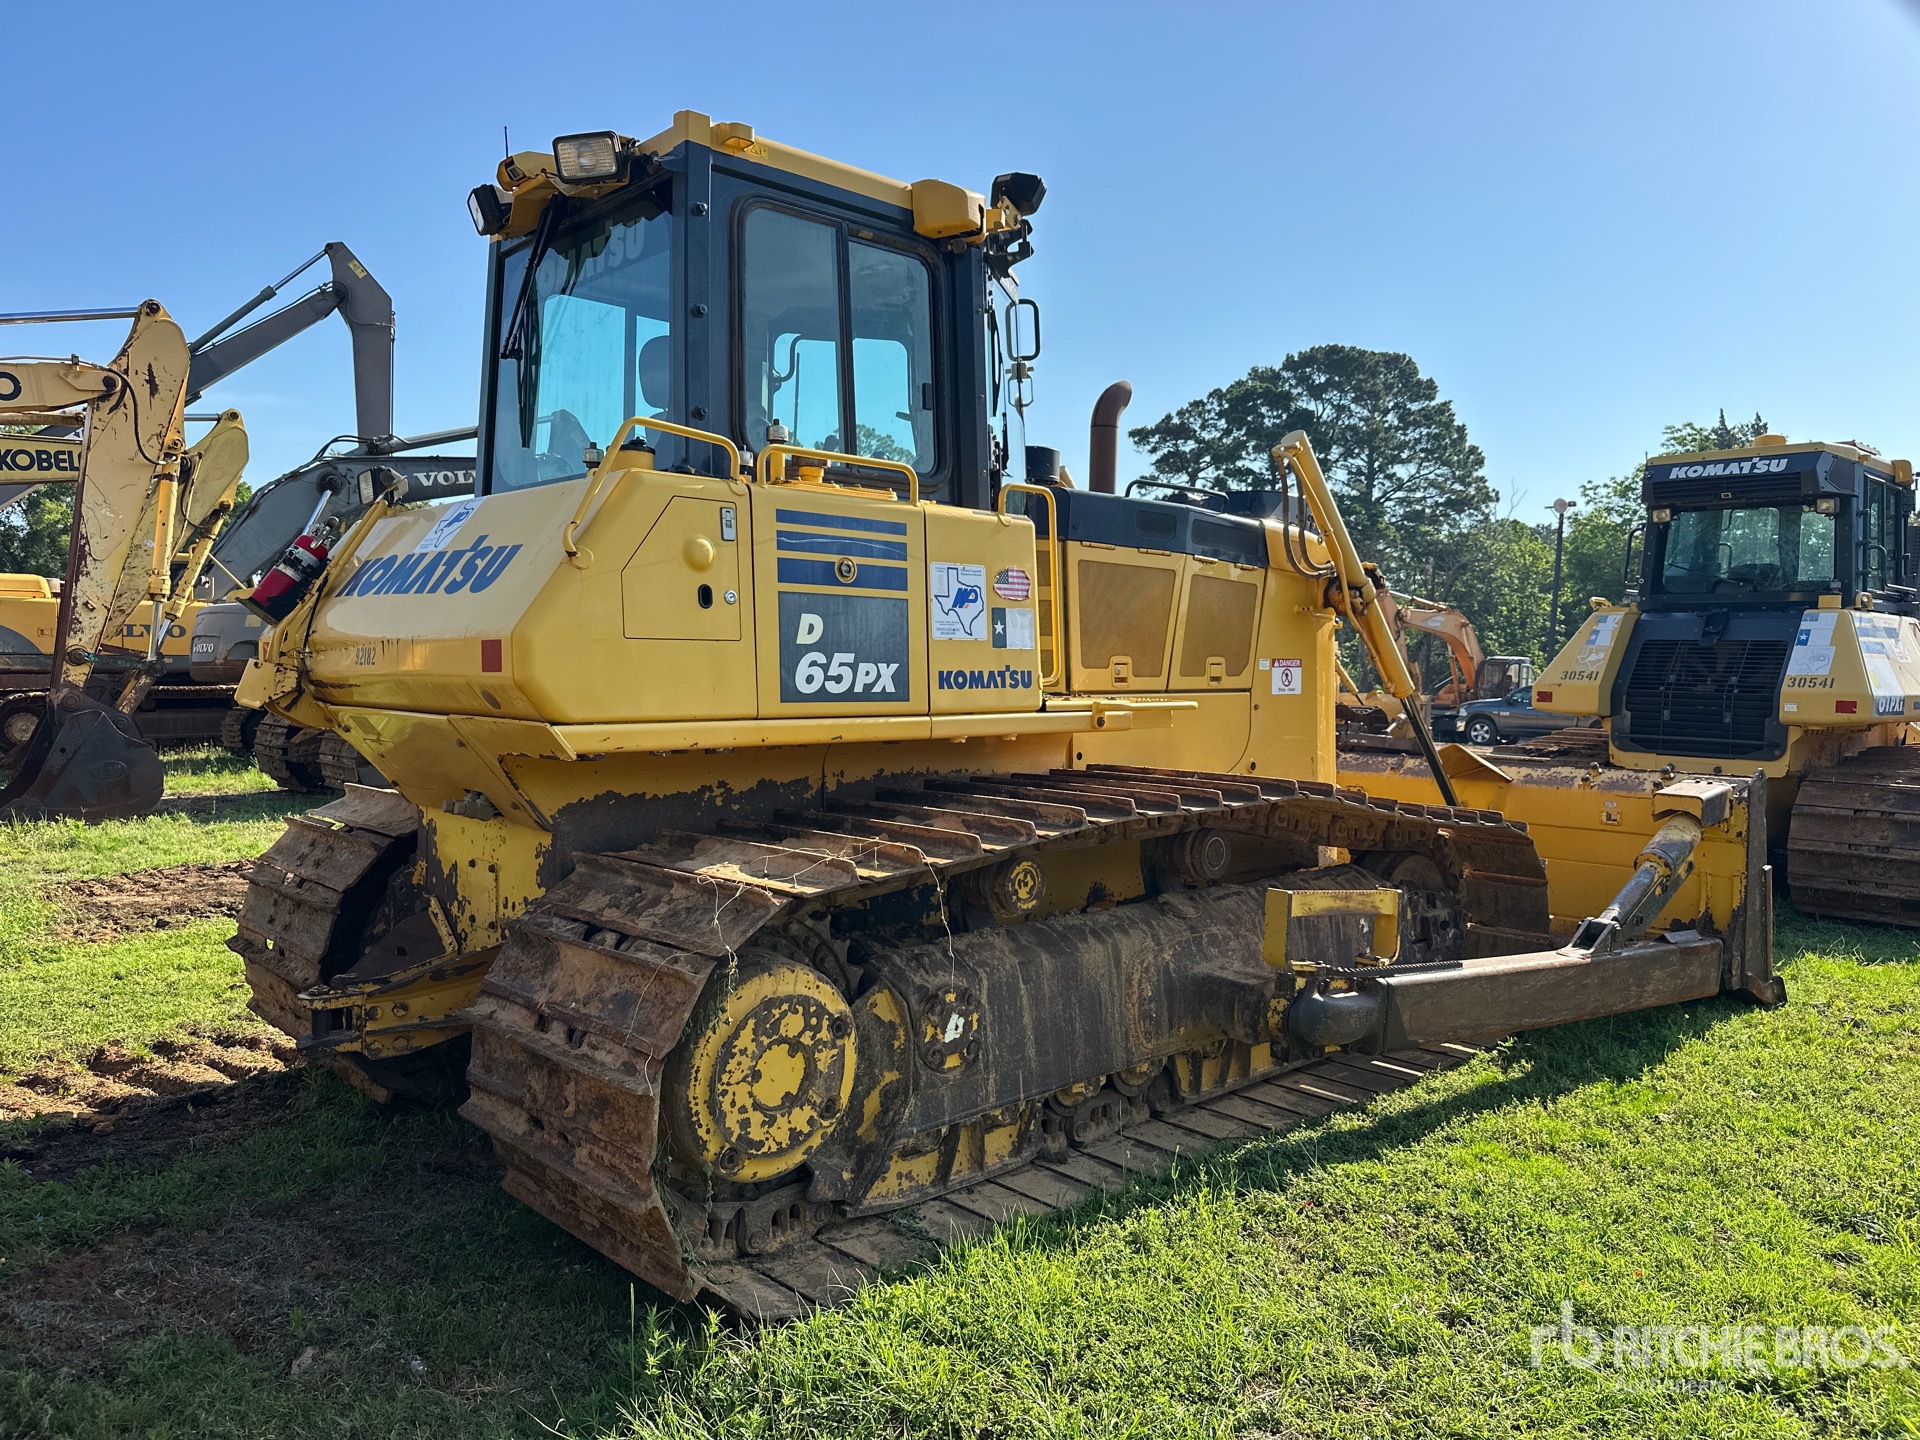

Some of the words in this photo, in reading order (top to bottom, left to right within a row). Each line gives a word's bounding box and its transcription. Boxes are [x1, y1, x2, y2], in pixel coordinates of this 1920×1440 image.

[0, 448, 82, 472] KOBEL
[1669, 457, 1788, 480] KOMATSU
[335, 534, 524, 598] KOMATSU
[796, 613, 824, 645] D
[355, 646, 376, 666] 92182
[1279, 659, 1301, 667] DANGER
[938, 664, 1032, 690] KOMATSU
[1560, 670, 1600, 681] 30541
[1787, 677, 1835, 689] 30541
